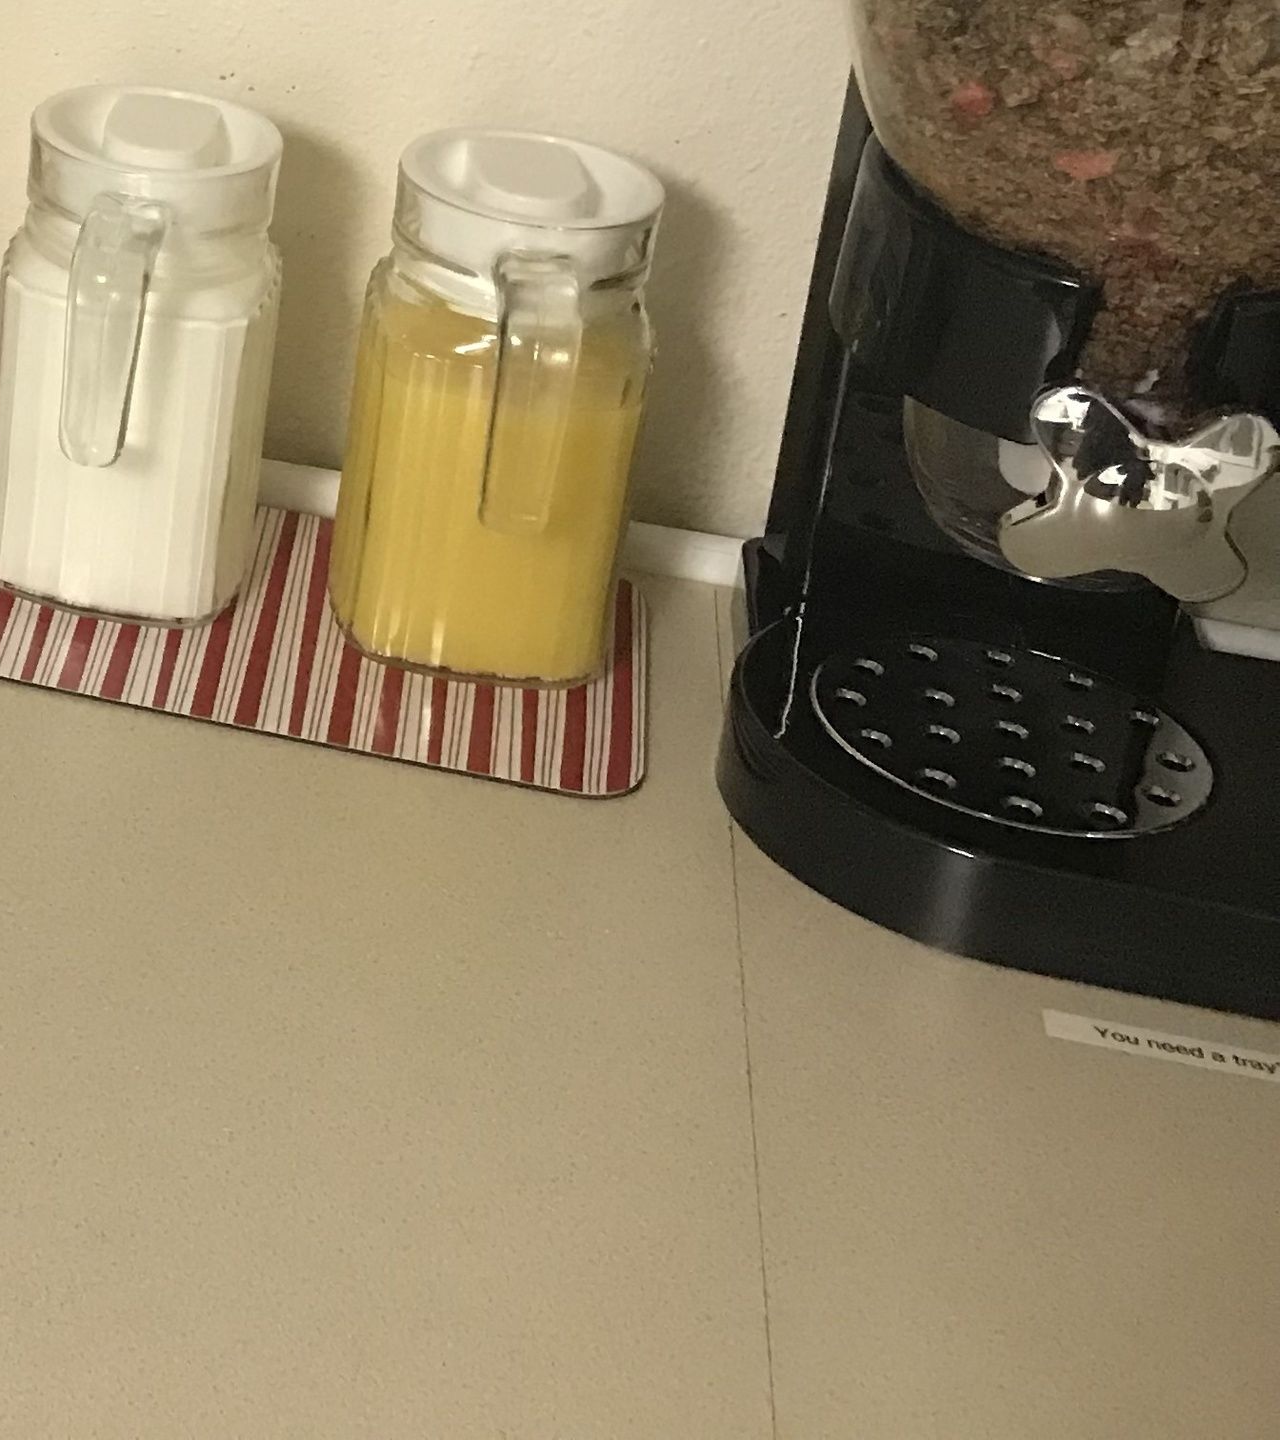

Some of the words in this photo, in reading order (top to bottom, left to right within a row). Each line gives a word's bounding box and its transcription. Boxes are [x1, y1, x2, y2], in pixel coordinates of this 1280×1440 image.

[1093, 1024, 1140, 1046] You
[1146, 1038, 1205, 1060] need
[1211, 1051, 1227, 1063] a
